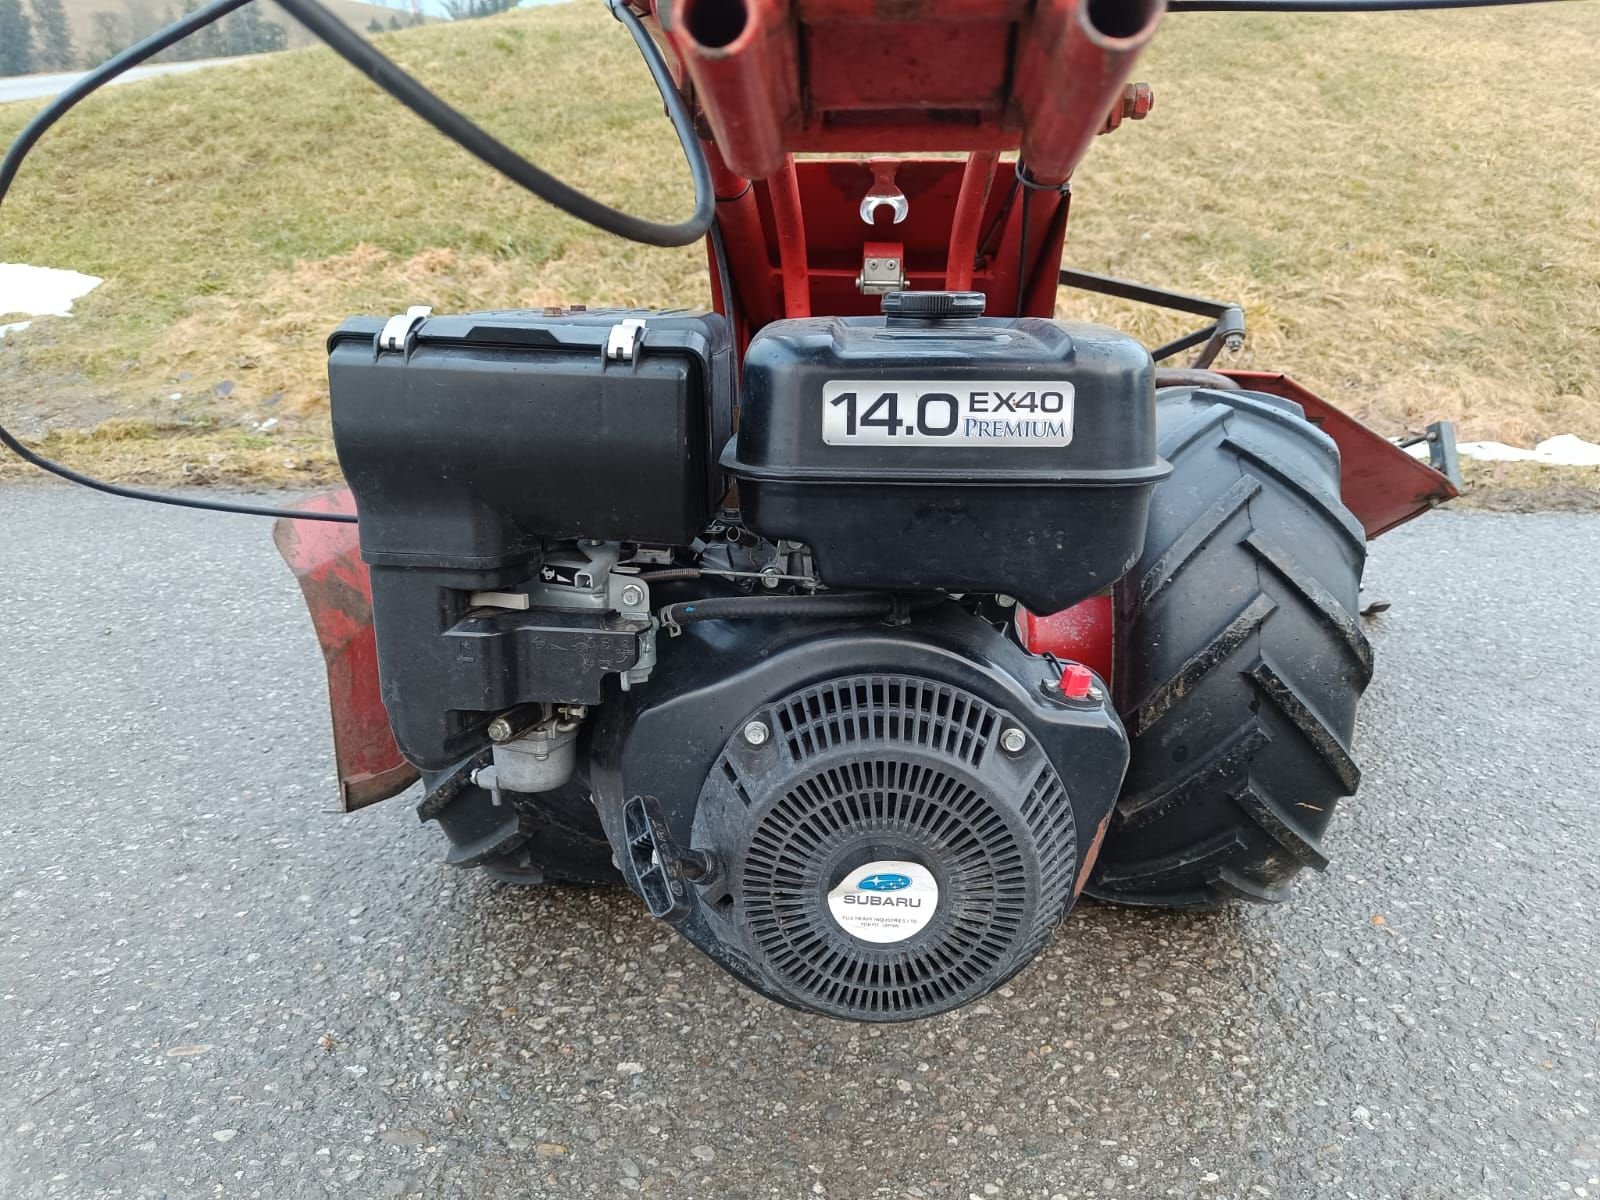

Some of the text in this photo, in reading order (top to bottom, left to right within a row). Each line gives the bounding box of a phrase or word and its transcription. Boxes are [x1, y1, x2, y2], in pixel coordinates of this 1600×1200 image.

[969, 391, 1064, 413] EX40
[830, 392, 959, 437] 14.0
[963, 416, 1066, 438] PREMIUM
[843, 895, 922, 908] SUBARU
